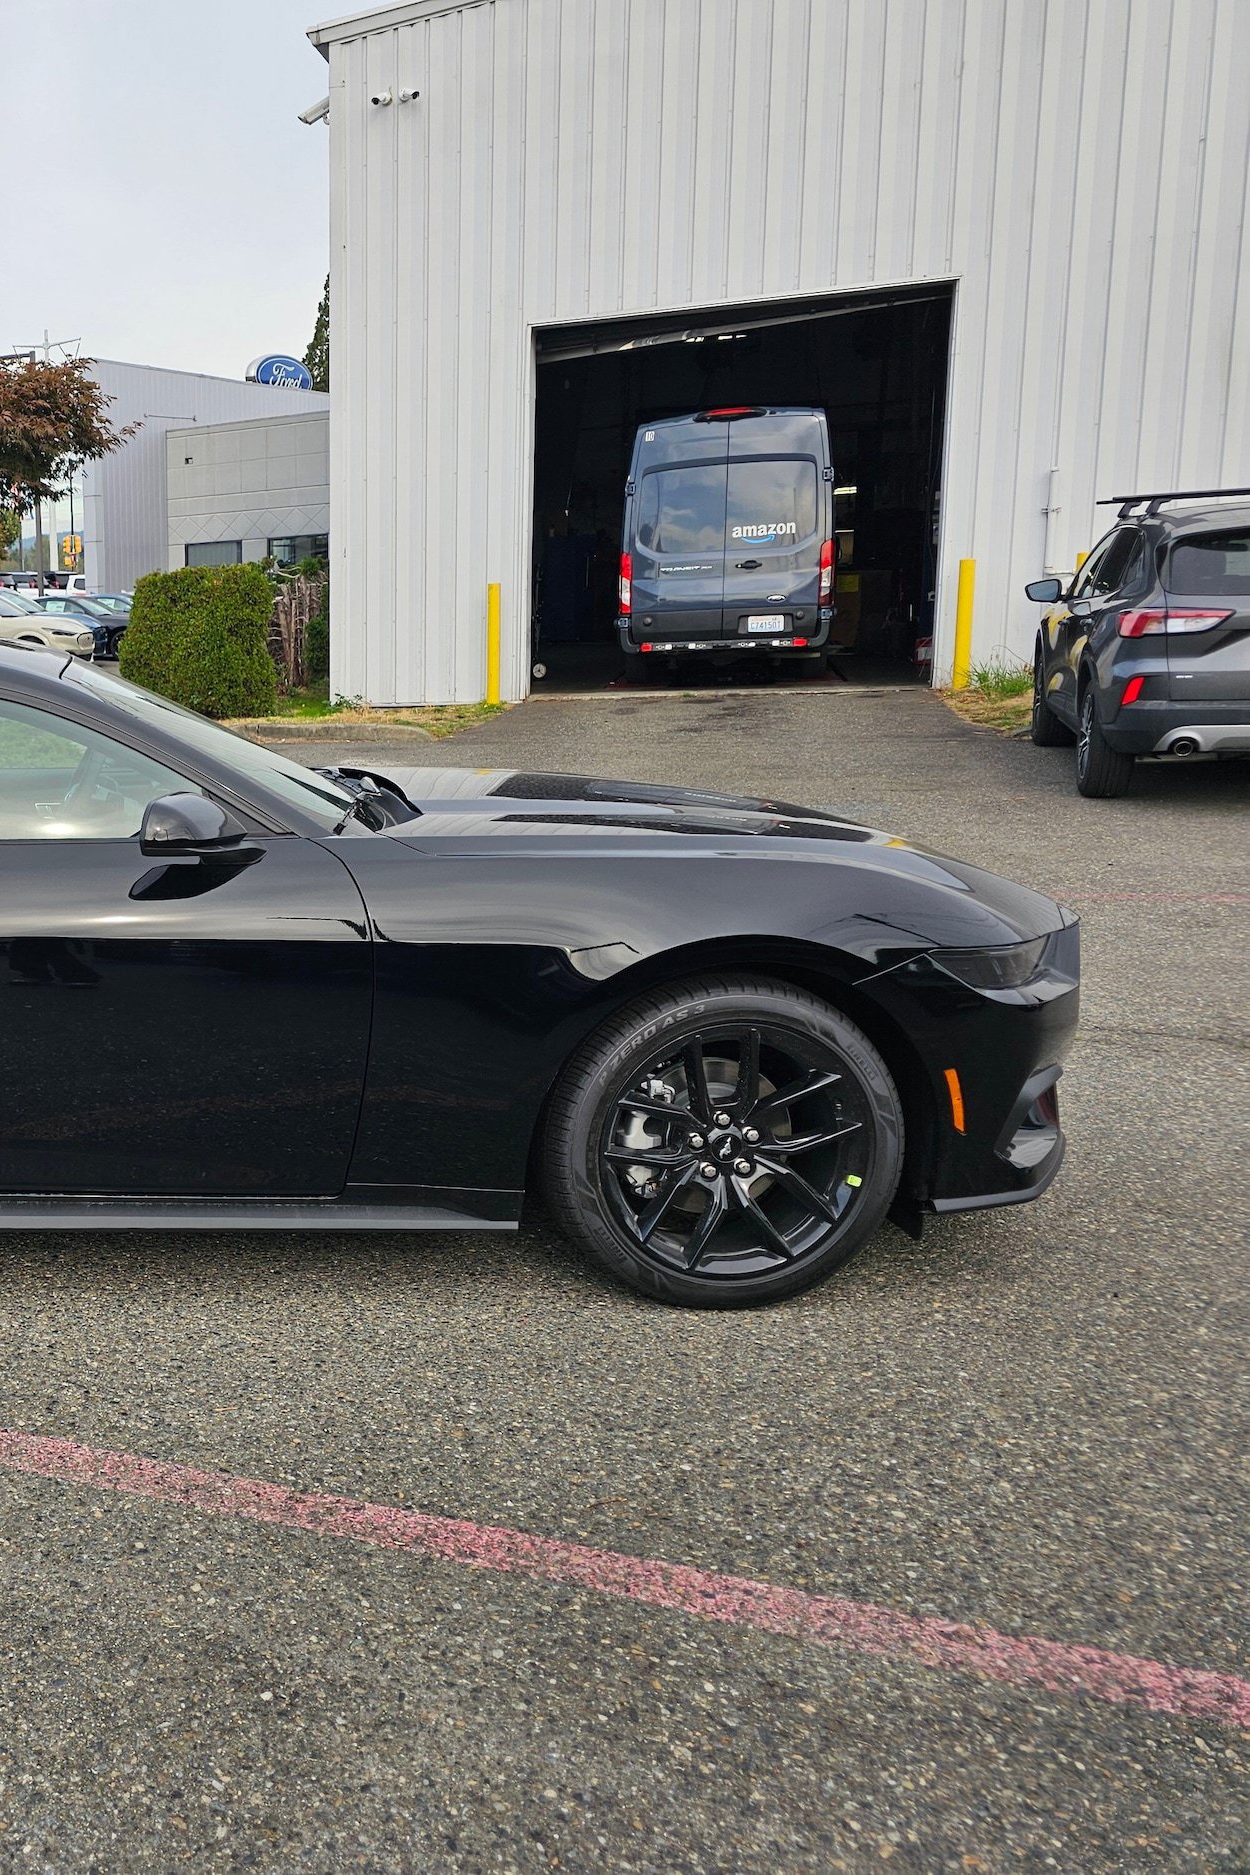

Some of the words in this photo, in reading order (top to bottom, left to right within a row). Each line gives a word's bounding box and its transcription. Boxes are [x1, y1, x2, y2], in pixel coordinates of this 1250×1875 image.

[269, 363, 303, 388] Ford
[732, 521, 797, 538] amazon
[609, 1024, 657, 1071] ZERO
[662, 1009, 689, 1029] AS
[693, 1004, 706, 1015] 3
